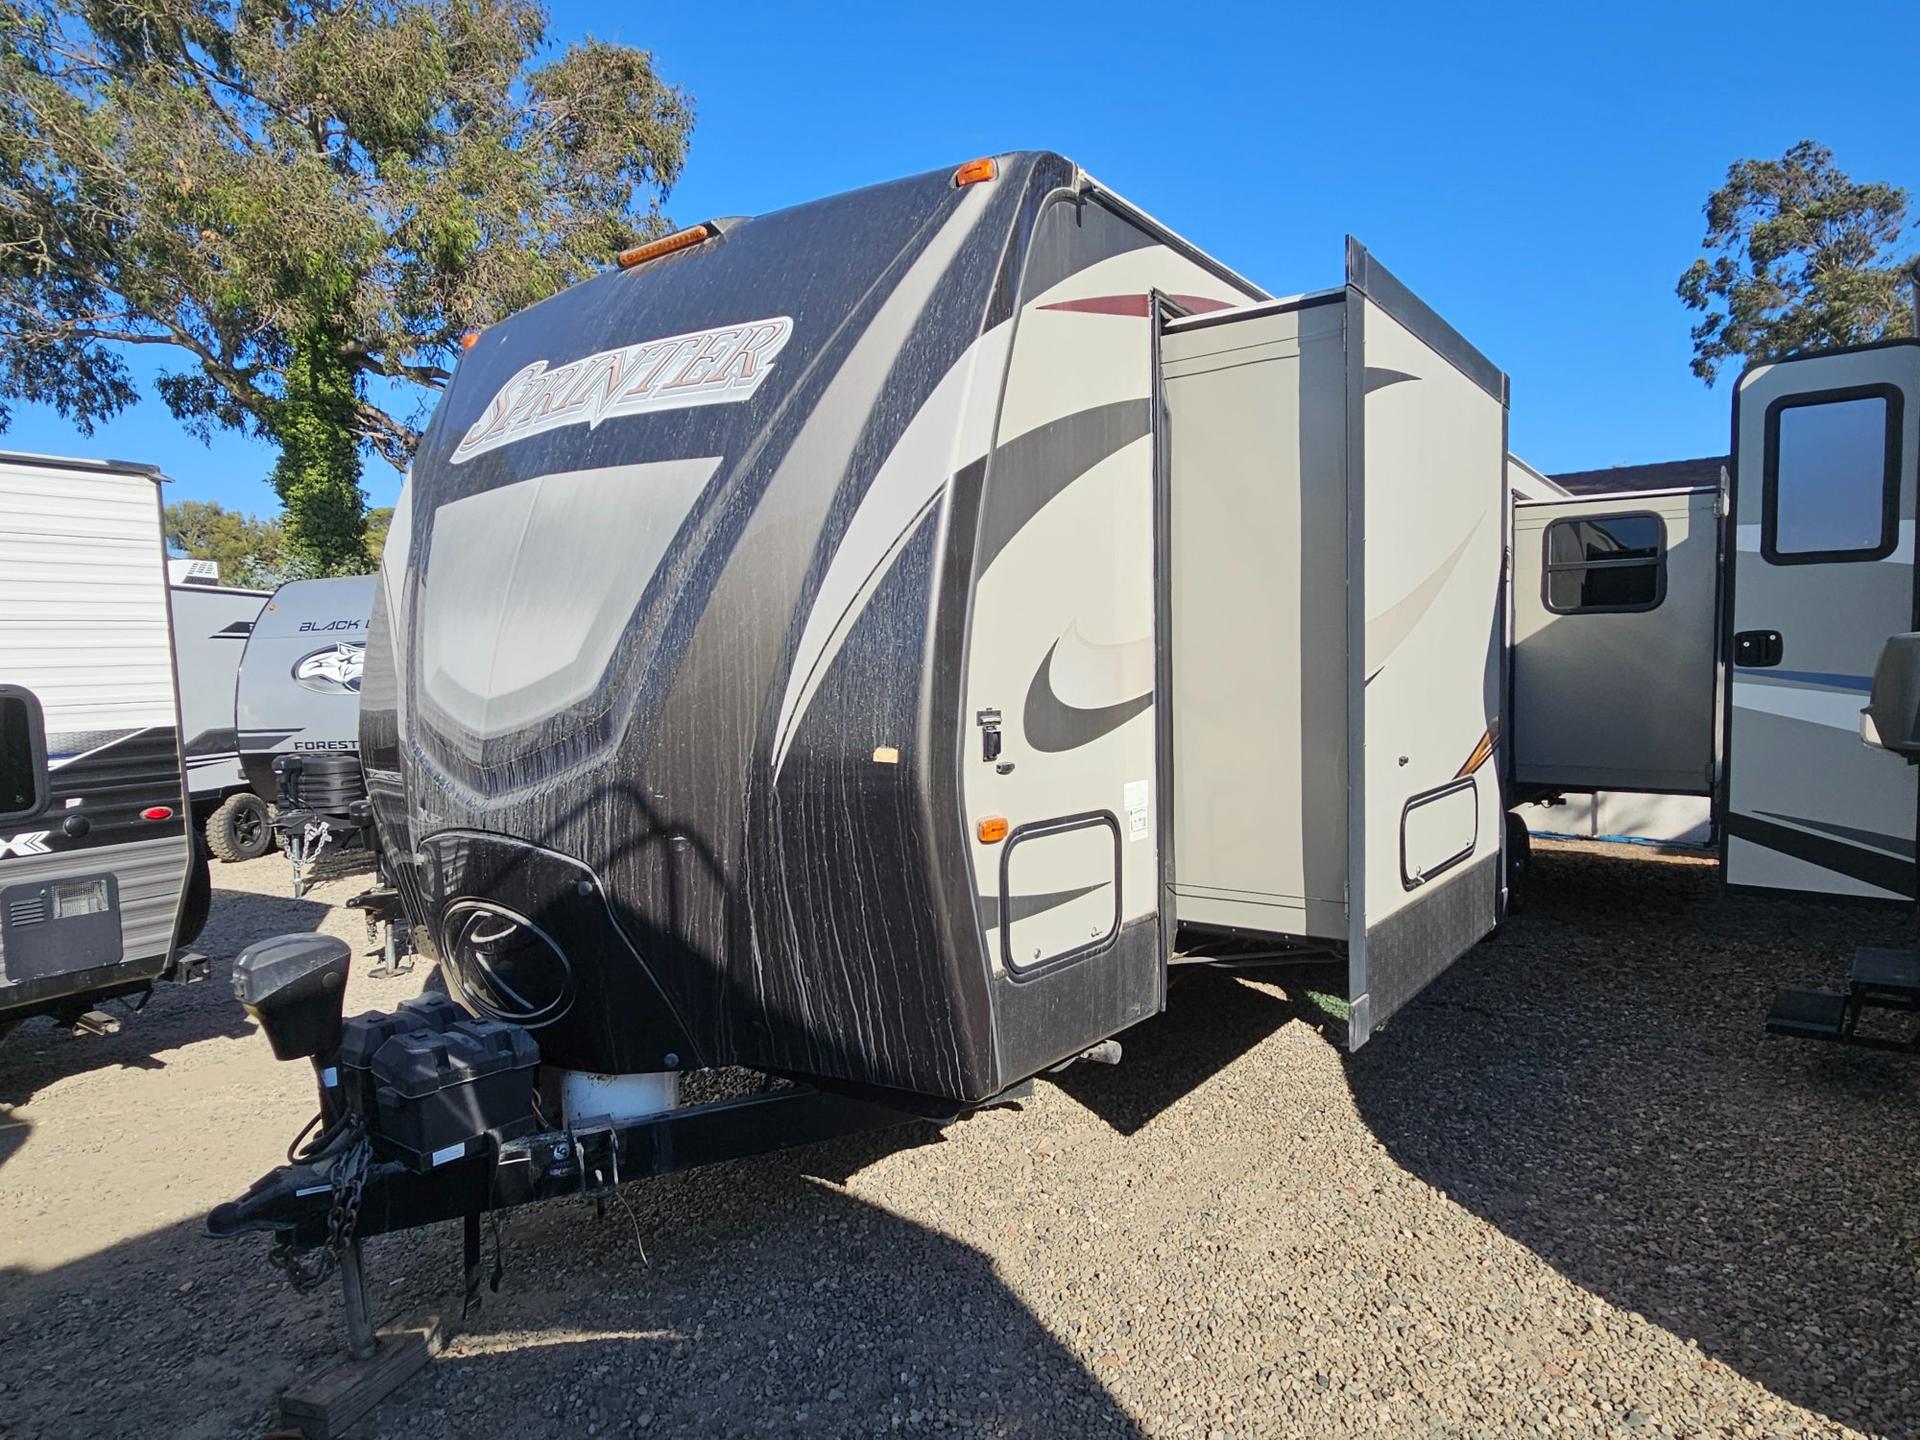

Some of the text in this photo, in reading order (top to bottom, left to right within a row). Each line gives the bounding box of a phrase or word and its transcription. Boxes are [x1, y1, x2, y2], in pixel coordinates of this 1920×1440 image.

[457, 318, 788, 450] SPRINTER
[299, 619, 361, 632] BLACK
[294, 740, 359, 750] FOREST
